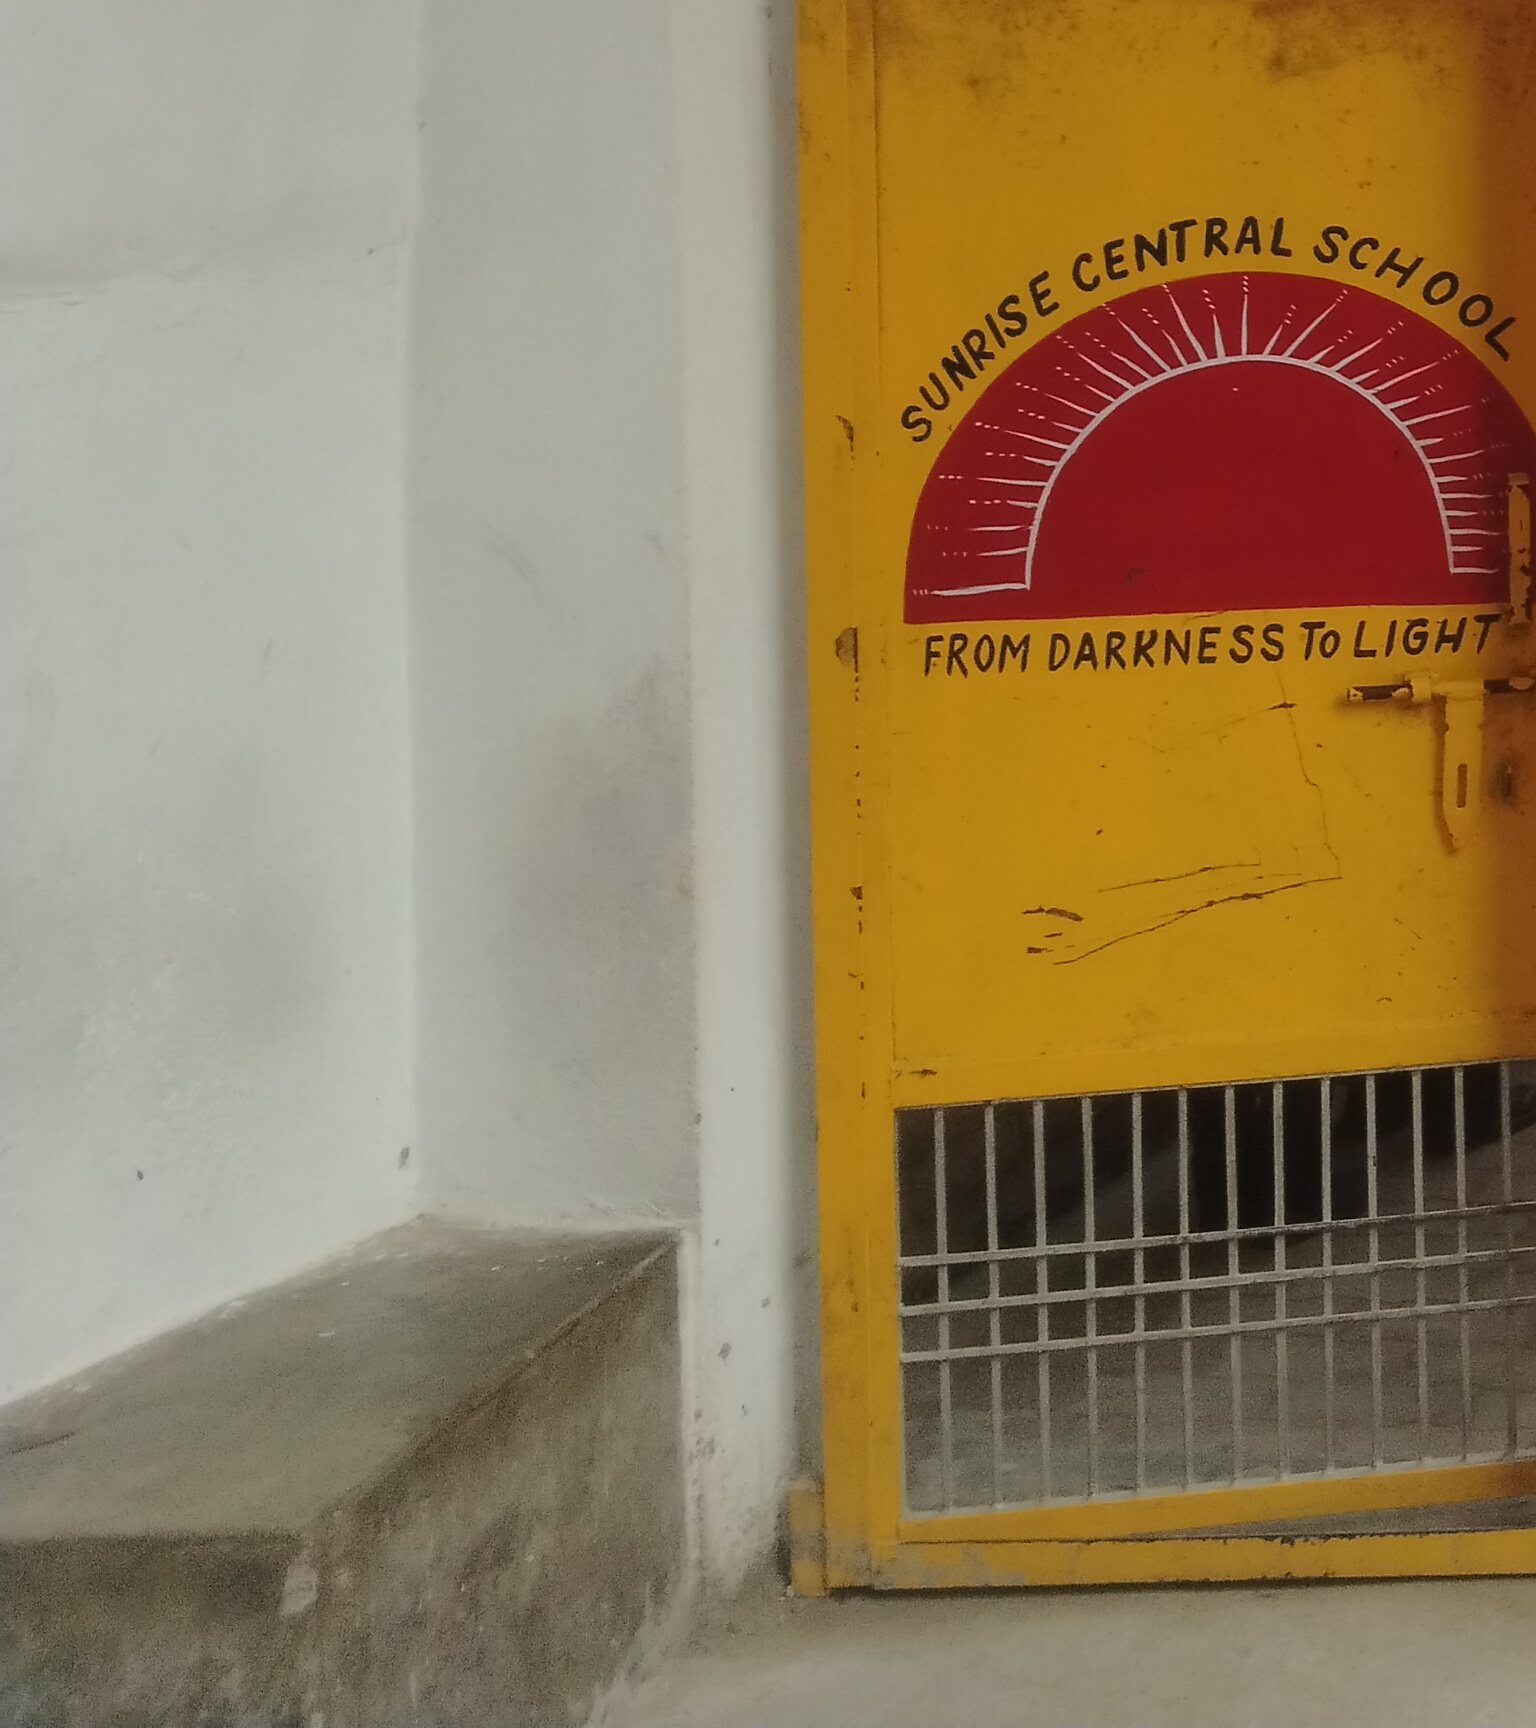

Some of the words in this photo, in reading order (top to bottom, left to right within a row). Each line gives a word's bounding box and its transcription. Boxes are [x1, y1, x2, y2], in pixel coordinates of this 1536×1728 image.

[902, 271, 1060, 443] SUNRISE
[1072, 215, 1292, 293] CENTRAL
[1313, 225, 1517, 361] SCHOOL
[924, 632, 1029, 679] FROM
[1048, 623, 1285, 672] DARKNESS
[1354, 613, 1500, 658] LIGHT
